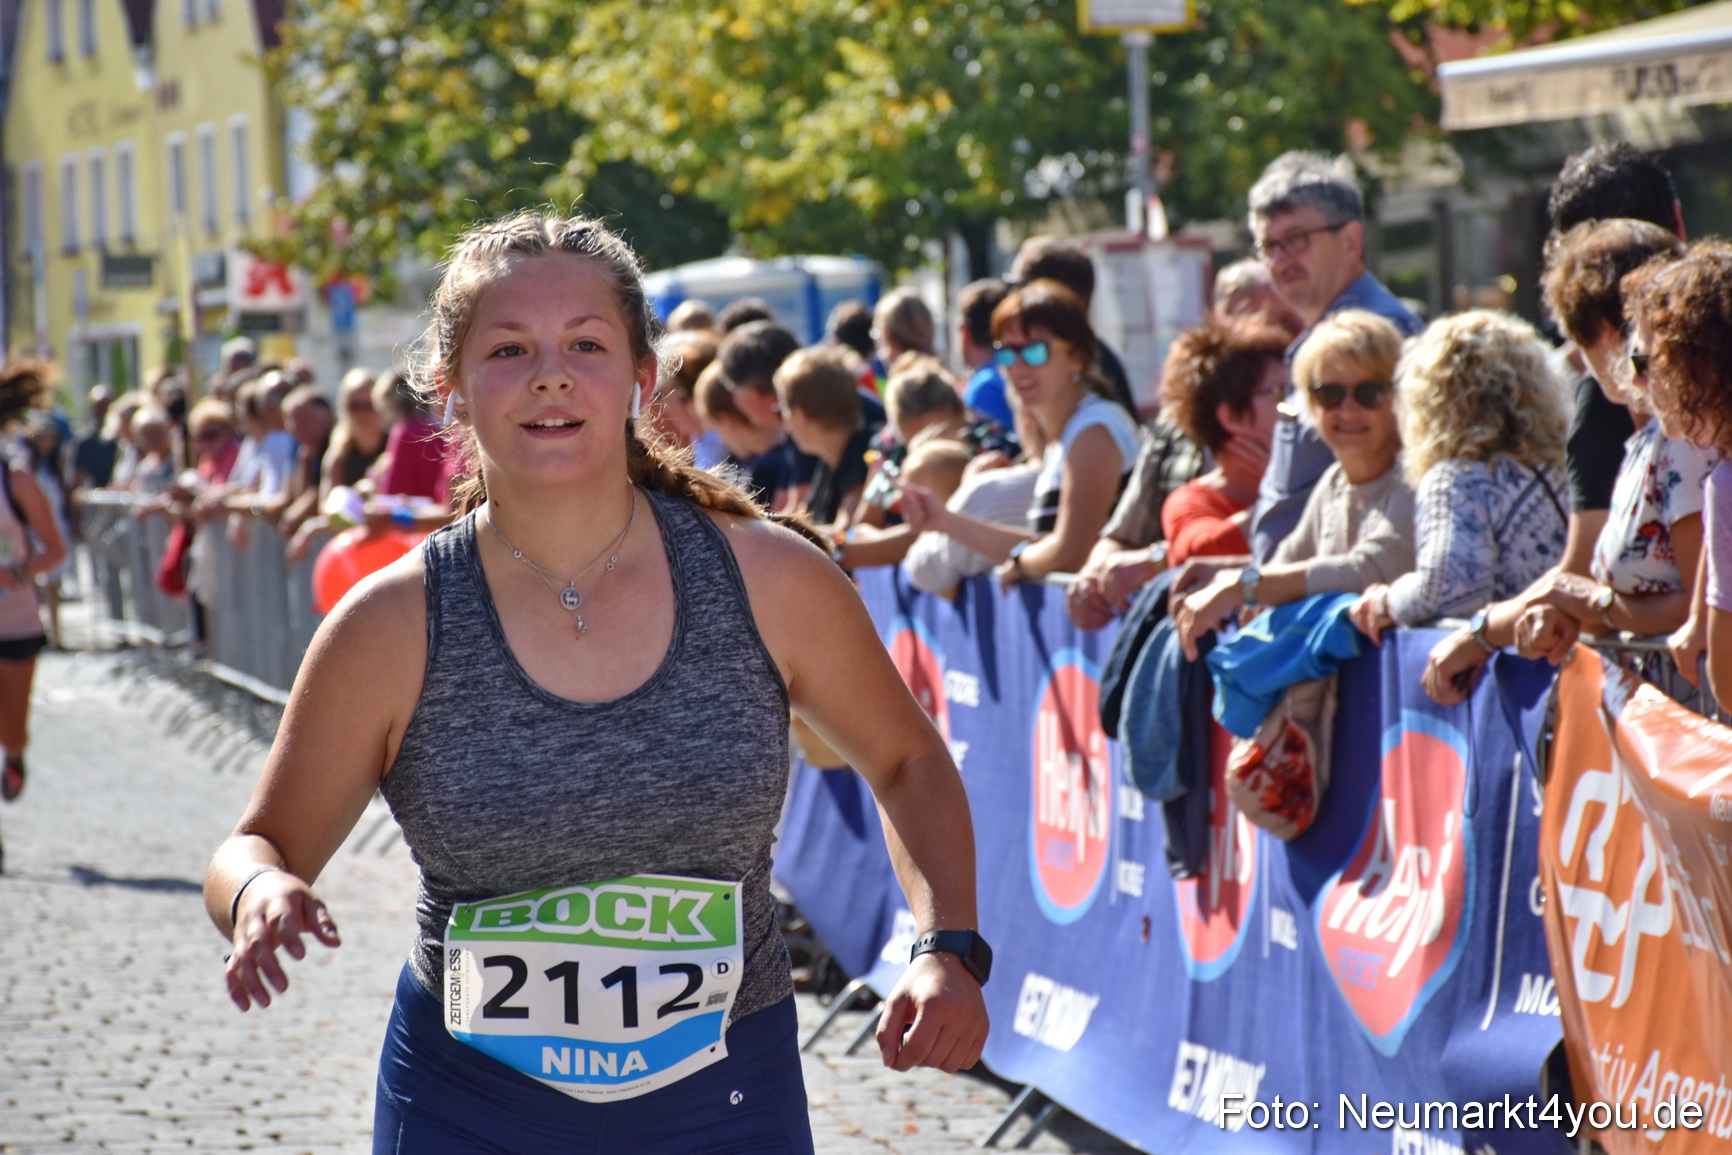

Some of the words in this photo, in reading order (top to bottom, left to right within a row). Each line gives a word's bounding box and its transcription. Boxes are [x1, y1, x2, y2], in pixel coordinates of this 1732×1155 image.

[469, 884, 717, 942] BOCK
[716, 962, 729, 974] D
[483, 955, 704, 1029] 2112
[541, 1046, 649, 1077] NINA
